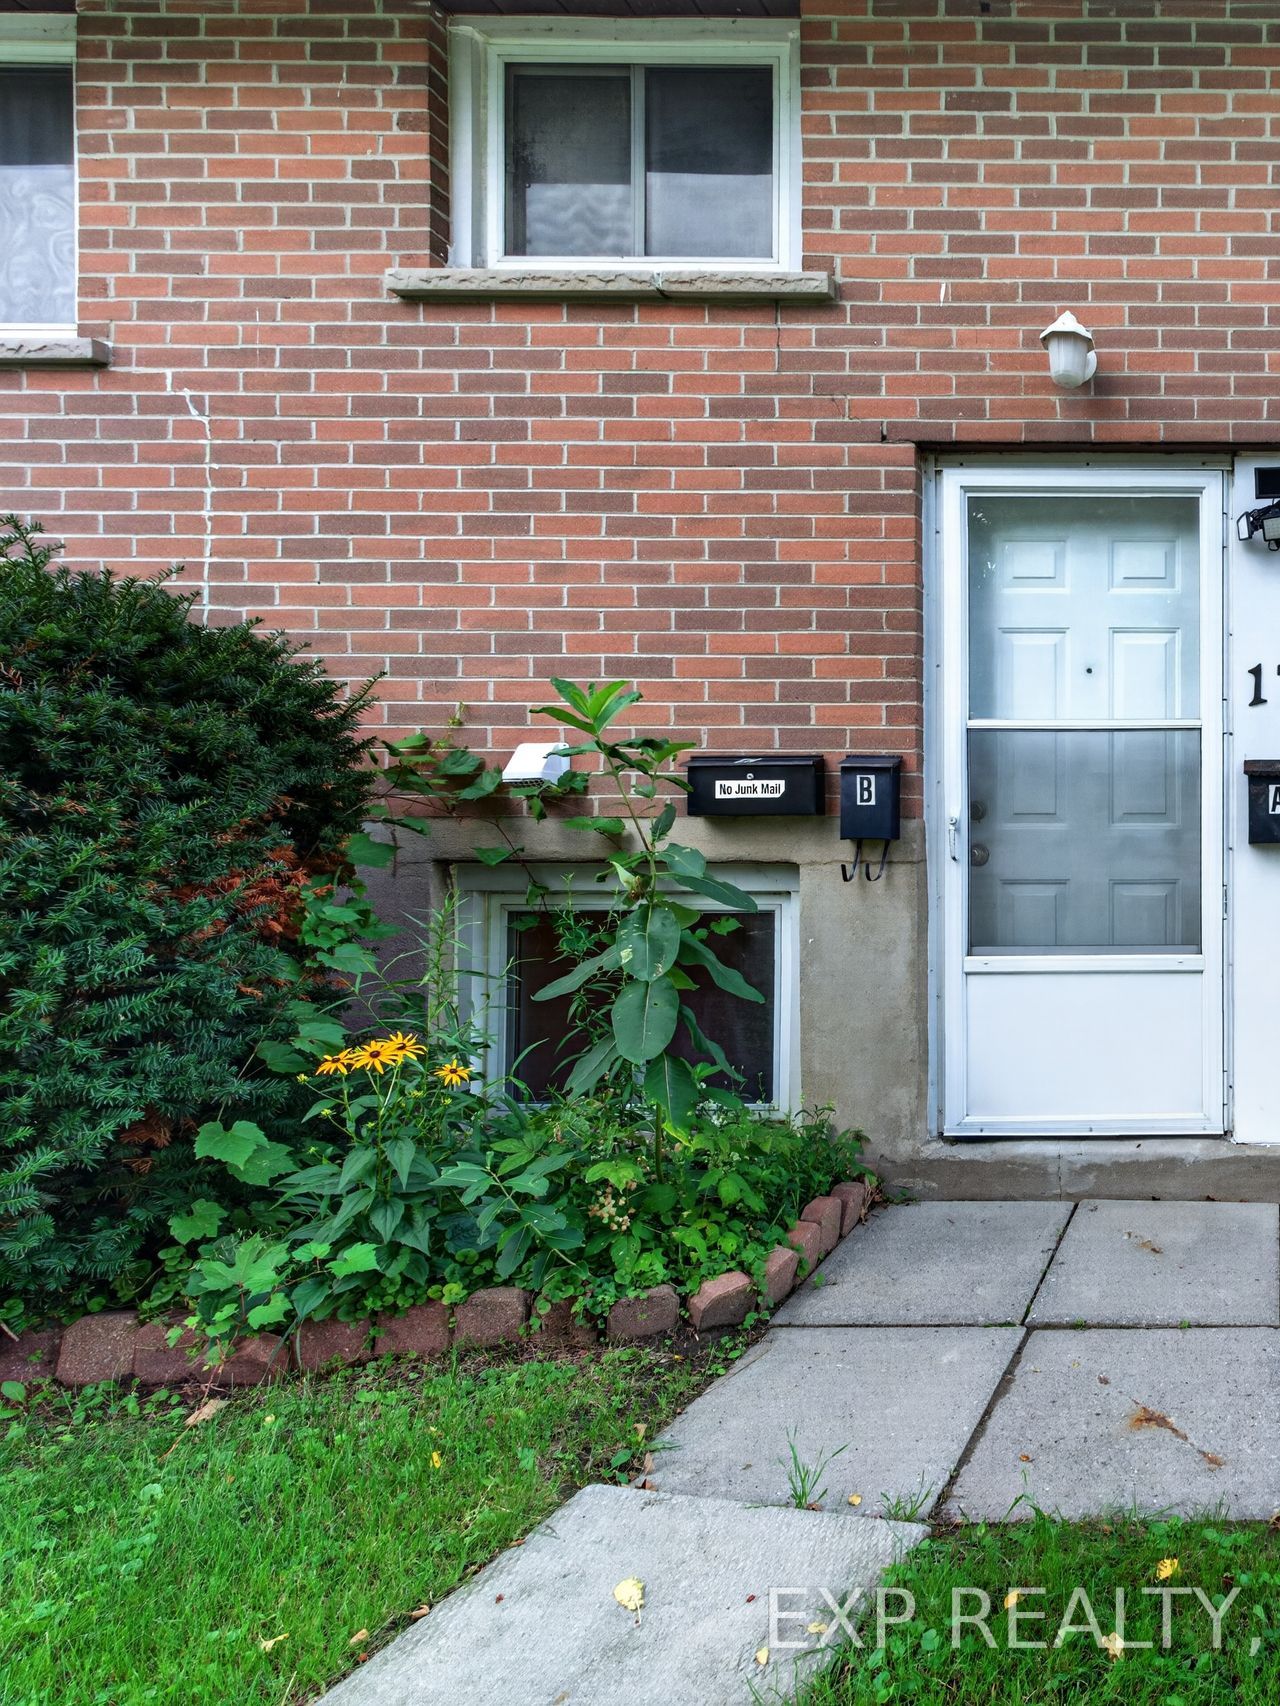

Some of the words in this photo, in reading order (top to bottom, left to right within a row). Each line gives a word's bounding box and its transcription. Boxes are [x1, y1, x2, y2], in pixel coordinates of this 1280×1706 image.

[719, 783, 733, 795] No
[735, 783, 758, 795] Junk
[761, 783, 781, 795] Mail
[859, 776, 873, 803] B
